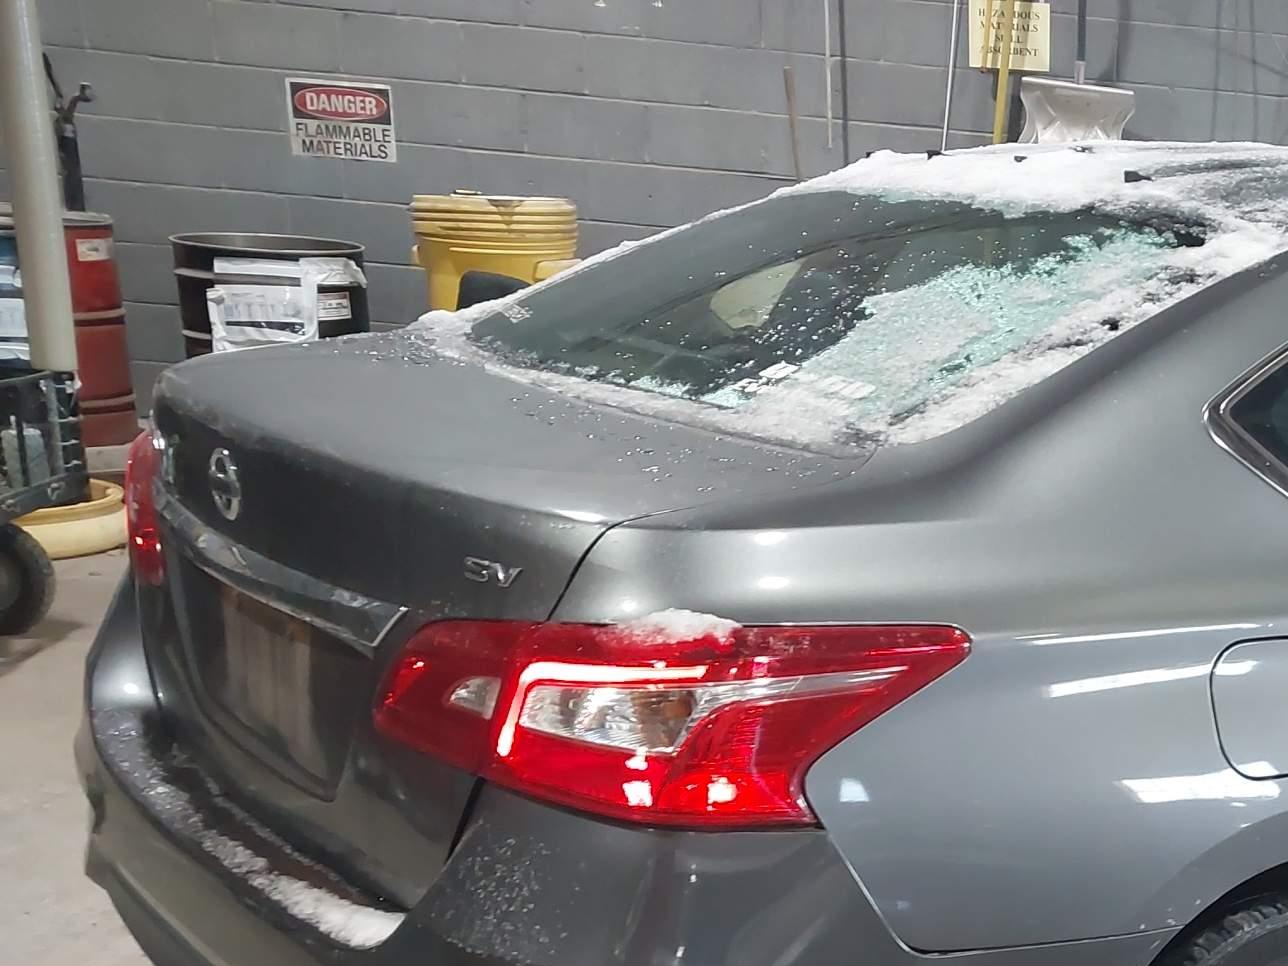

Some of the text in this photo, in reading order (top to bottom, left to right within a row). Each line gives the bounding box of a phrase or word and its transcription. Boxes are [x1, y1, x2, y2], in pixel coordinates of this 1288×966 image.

[978, 8, 1040, 20] HZADOUS
[305, 92, 377, 115] DANGER
[295, 122, 392, 143] FLAMMABLE
[301, 138, 389, 159] MATERIALS
[463, 556, 523, 588] SV
